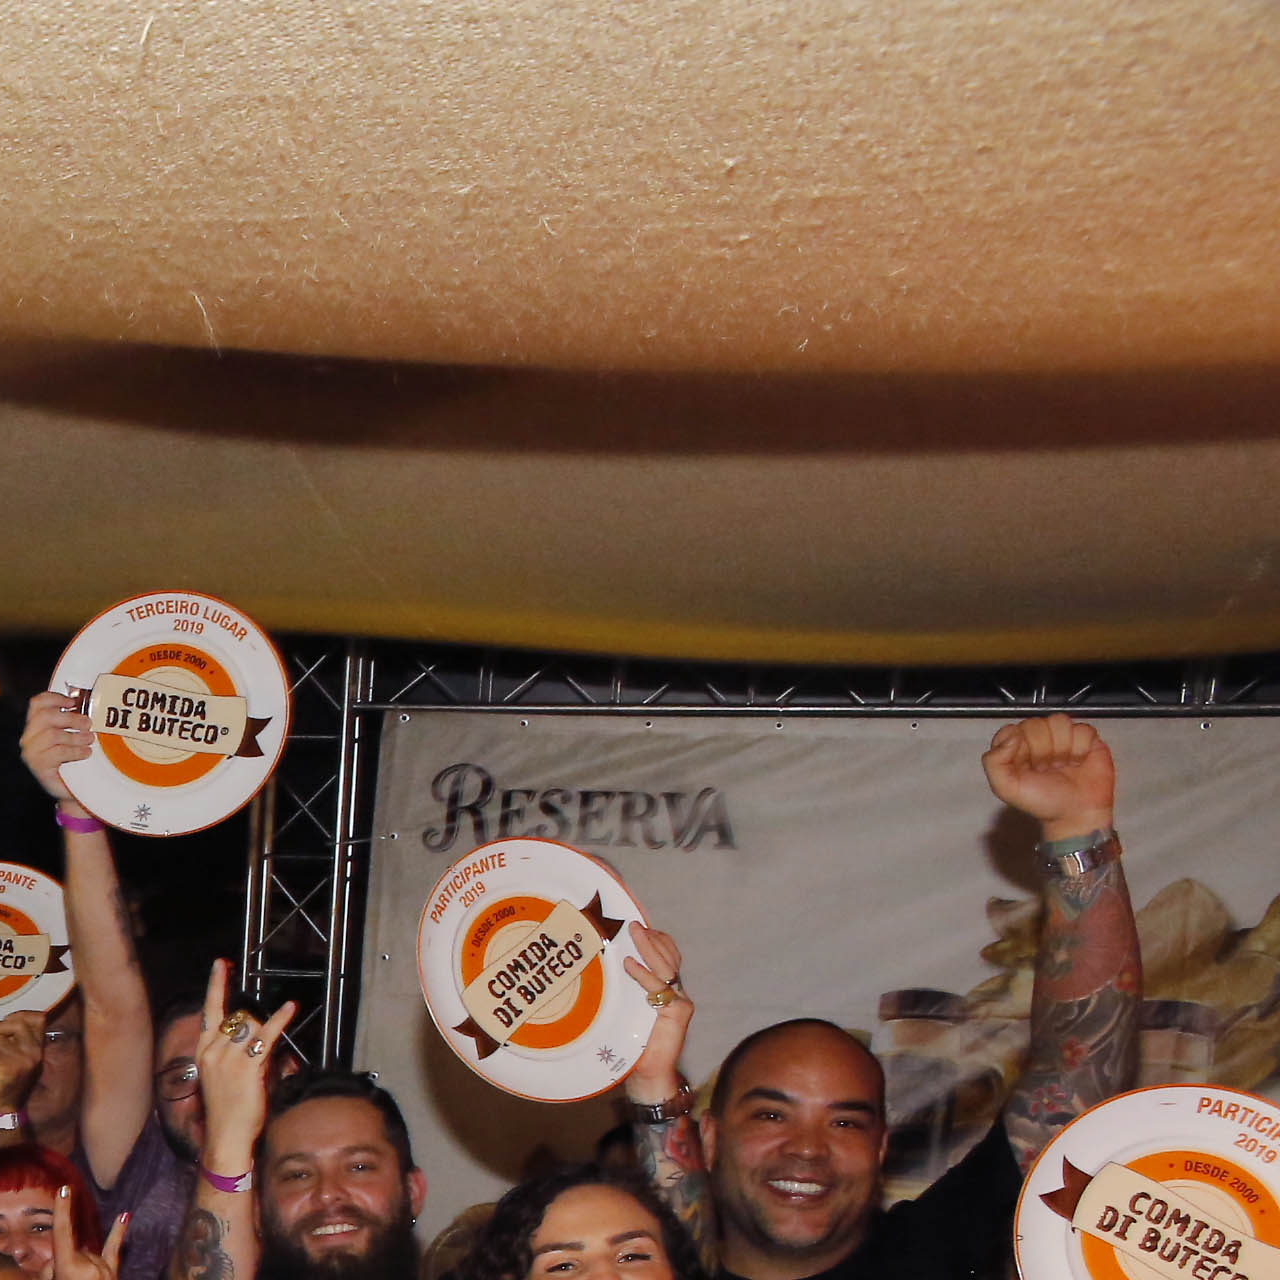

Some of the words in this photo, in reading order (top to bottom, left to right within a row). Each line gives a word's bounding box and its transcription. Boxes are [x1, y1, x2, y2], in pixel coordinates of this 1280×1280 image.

[126, 600, 200, 622] TERCEIRO
[203, 603, 248, 641] LUGAR
[173, 619, 204, 635] 2019
[150, 650, 181, 661] DESDE
[184, 653, 207, 670] 2000
[105, 707, 132, 729] DI
[122, 687, 206, 720] COMIDA
[429, 852, 506, 924] PARTICIPANTE
[459, 881, 486, 908] 2019
[471, 920, 493, 948] DESDE
[493, 906, 516, 924] 2000
[487, 933, 558, 999] COMIDA
[492, 999, 523, 1029] DI
[1234, 1133, 1277, 1163] 2019
[1184, 1160, 1229, 1182] DESDE
[1229, 1175, 1260, 1204] 2000
[1096, 1205, 1137, 1241] DI
[1128, 1192, 1242, 1265] COMIDA
